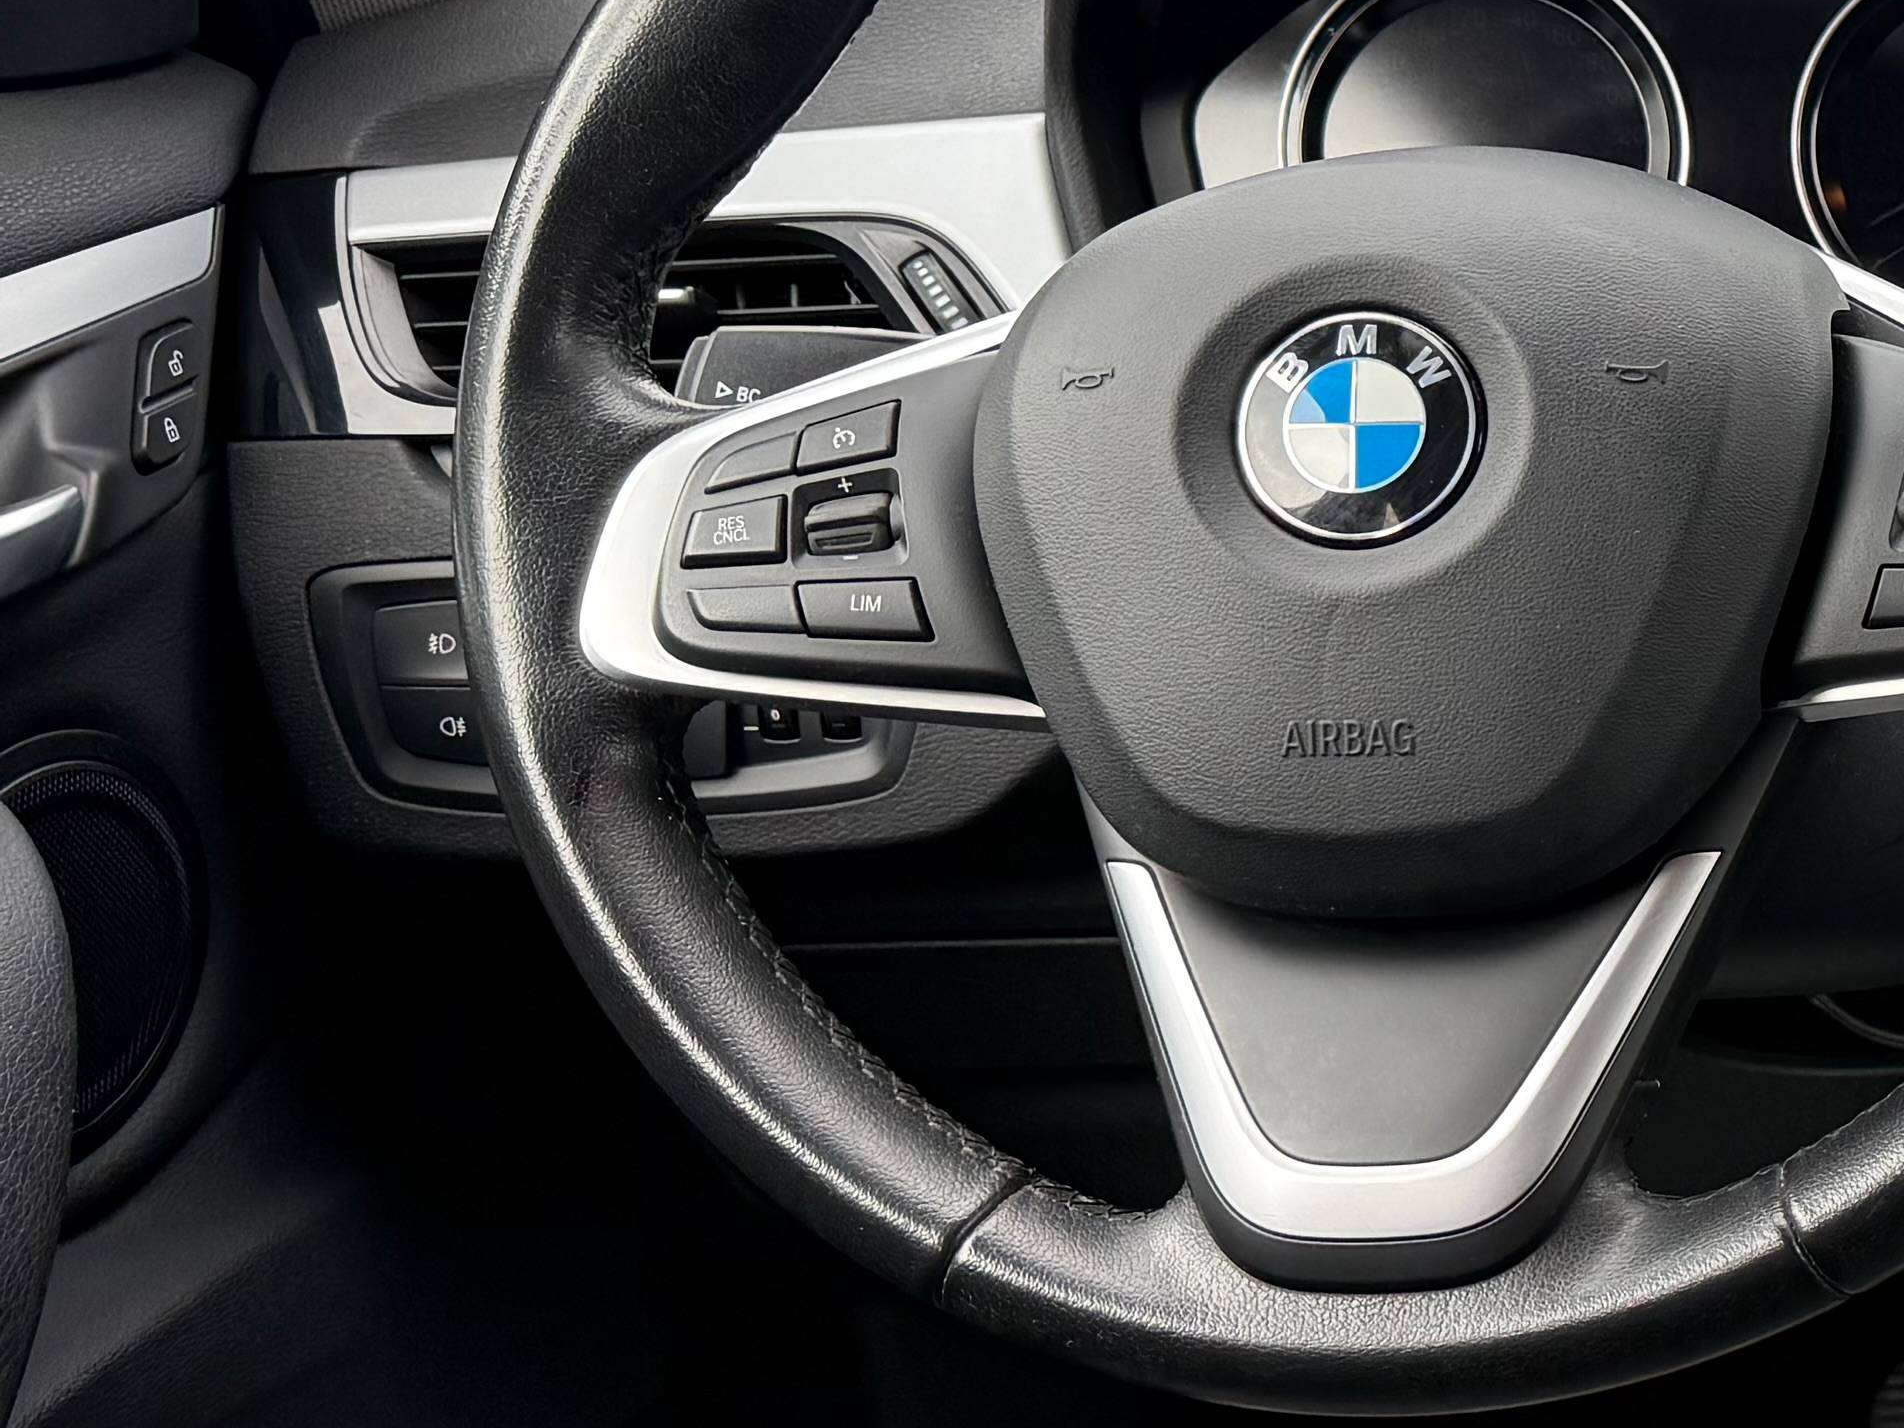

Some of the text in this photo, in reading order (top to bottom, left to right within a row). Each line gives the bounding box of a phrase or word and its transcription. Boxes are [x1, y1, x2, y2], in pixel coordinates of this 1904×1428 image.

[1267, 323, 1452, 393] BMW
[736, 387, 761, 403] BC
[718, 515, 745, 531] RES
[713, 528, 750, 545] CNCL
[850, 594, 882, 612] LIM
[1281, 719, 1417, 759] AIRBAG
